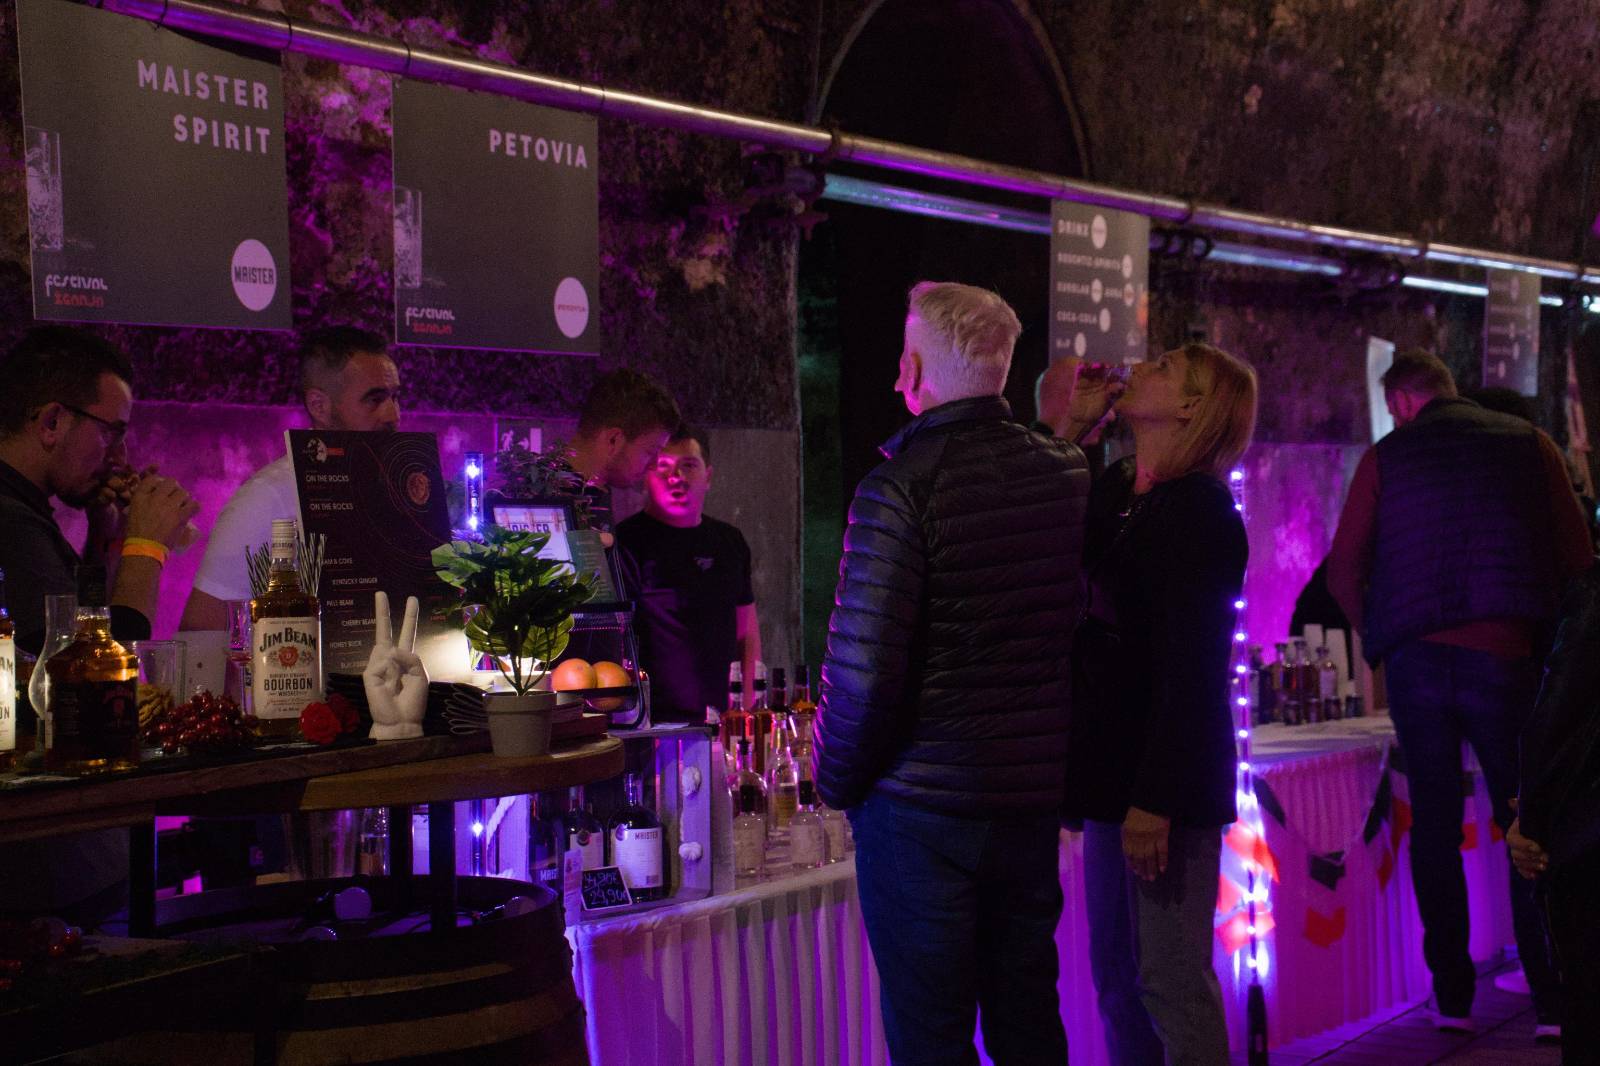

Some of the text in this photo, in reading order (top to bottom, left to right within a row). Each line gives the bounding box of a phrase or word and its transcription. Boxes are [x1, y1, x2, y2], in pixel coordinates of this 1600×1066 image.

[137, 59, 268, 110] MAISTER
[173, 113, 270, 154] SPIRIT
[489, 128, 587, 168] PETOVIA
[233, 265, 274, 284] MAISTER
[328, 474, 350, 482] ROCKS
[260, 627, 317, 652] JIM BEAM
[263, 678, 313, 691] BOURBON
